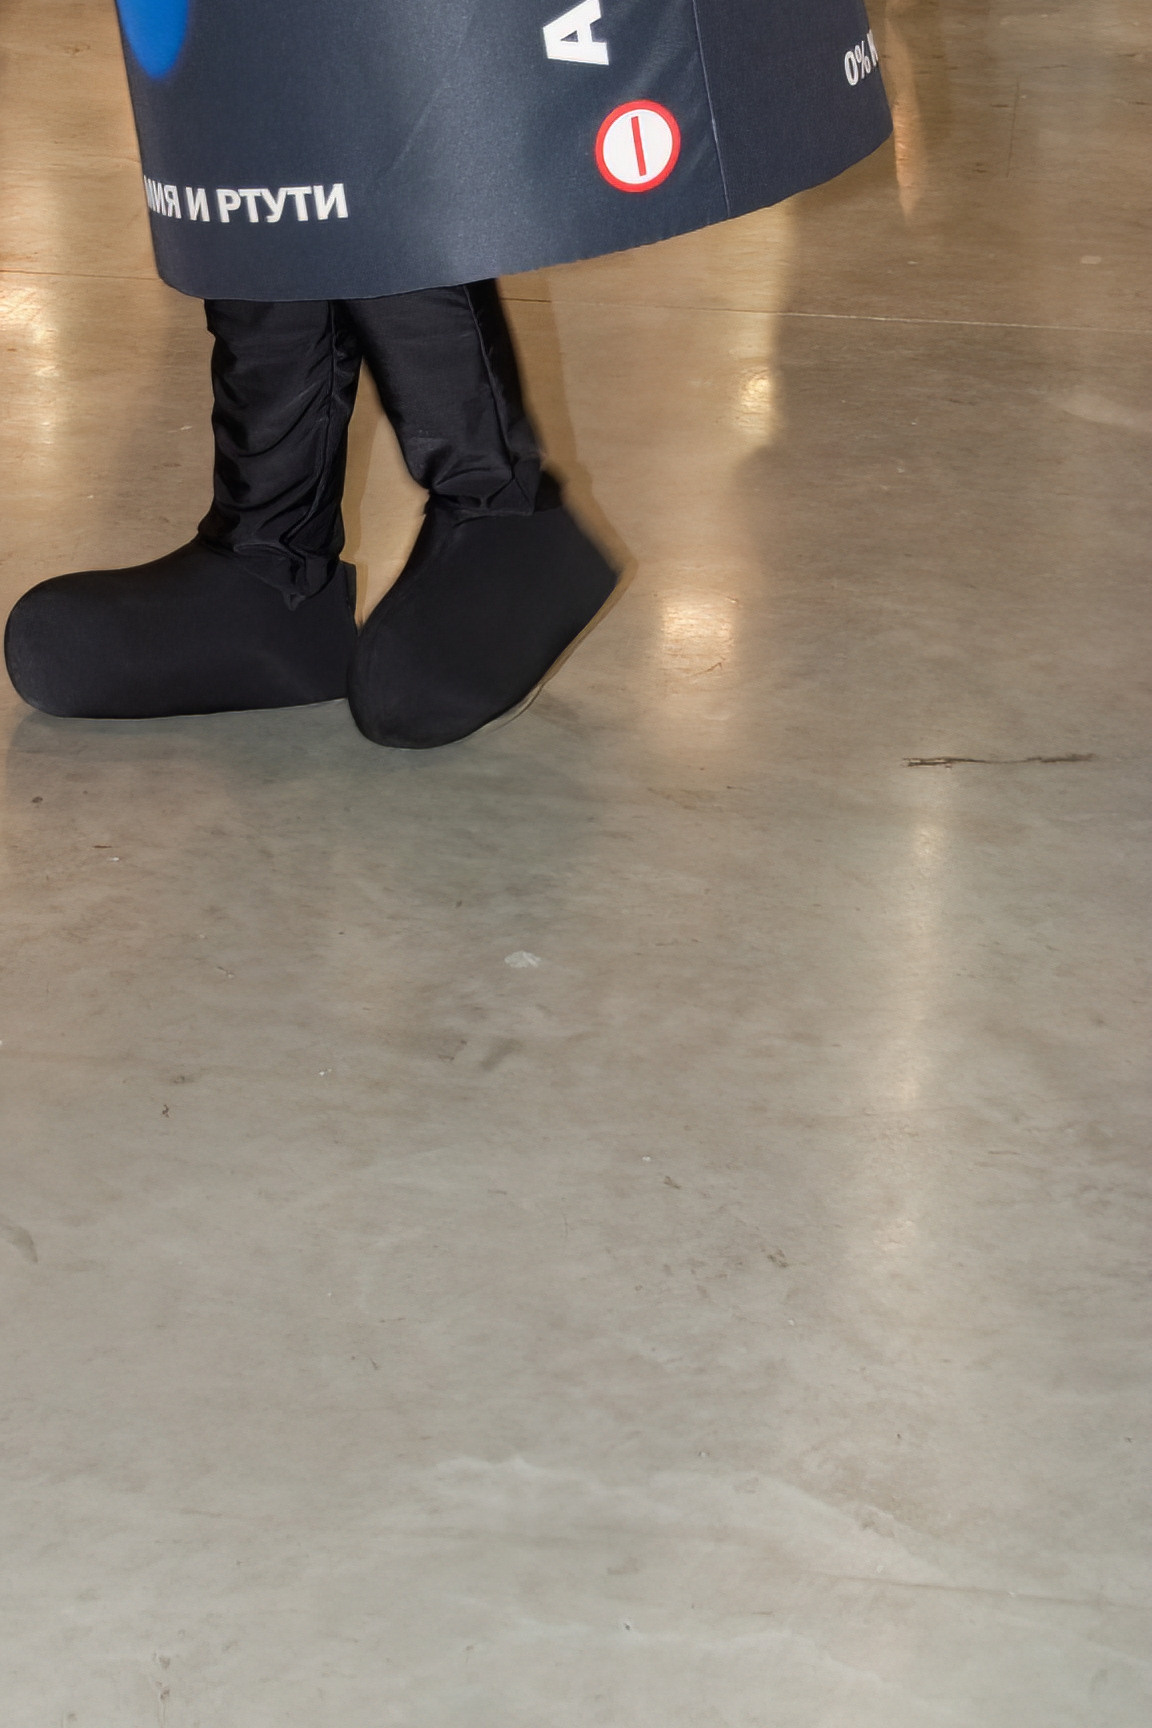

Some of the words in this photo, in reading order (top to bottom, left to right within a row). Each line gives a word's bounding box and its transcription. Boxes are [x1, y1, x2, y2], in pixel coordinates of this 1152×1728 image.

[844, 50, 871, 86] 0%
[185, 185, 211, 223] И
[215, 182, 349, 223] РТУТИ
